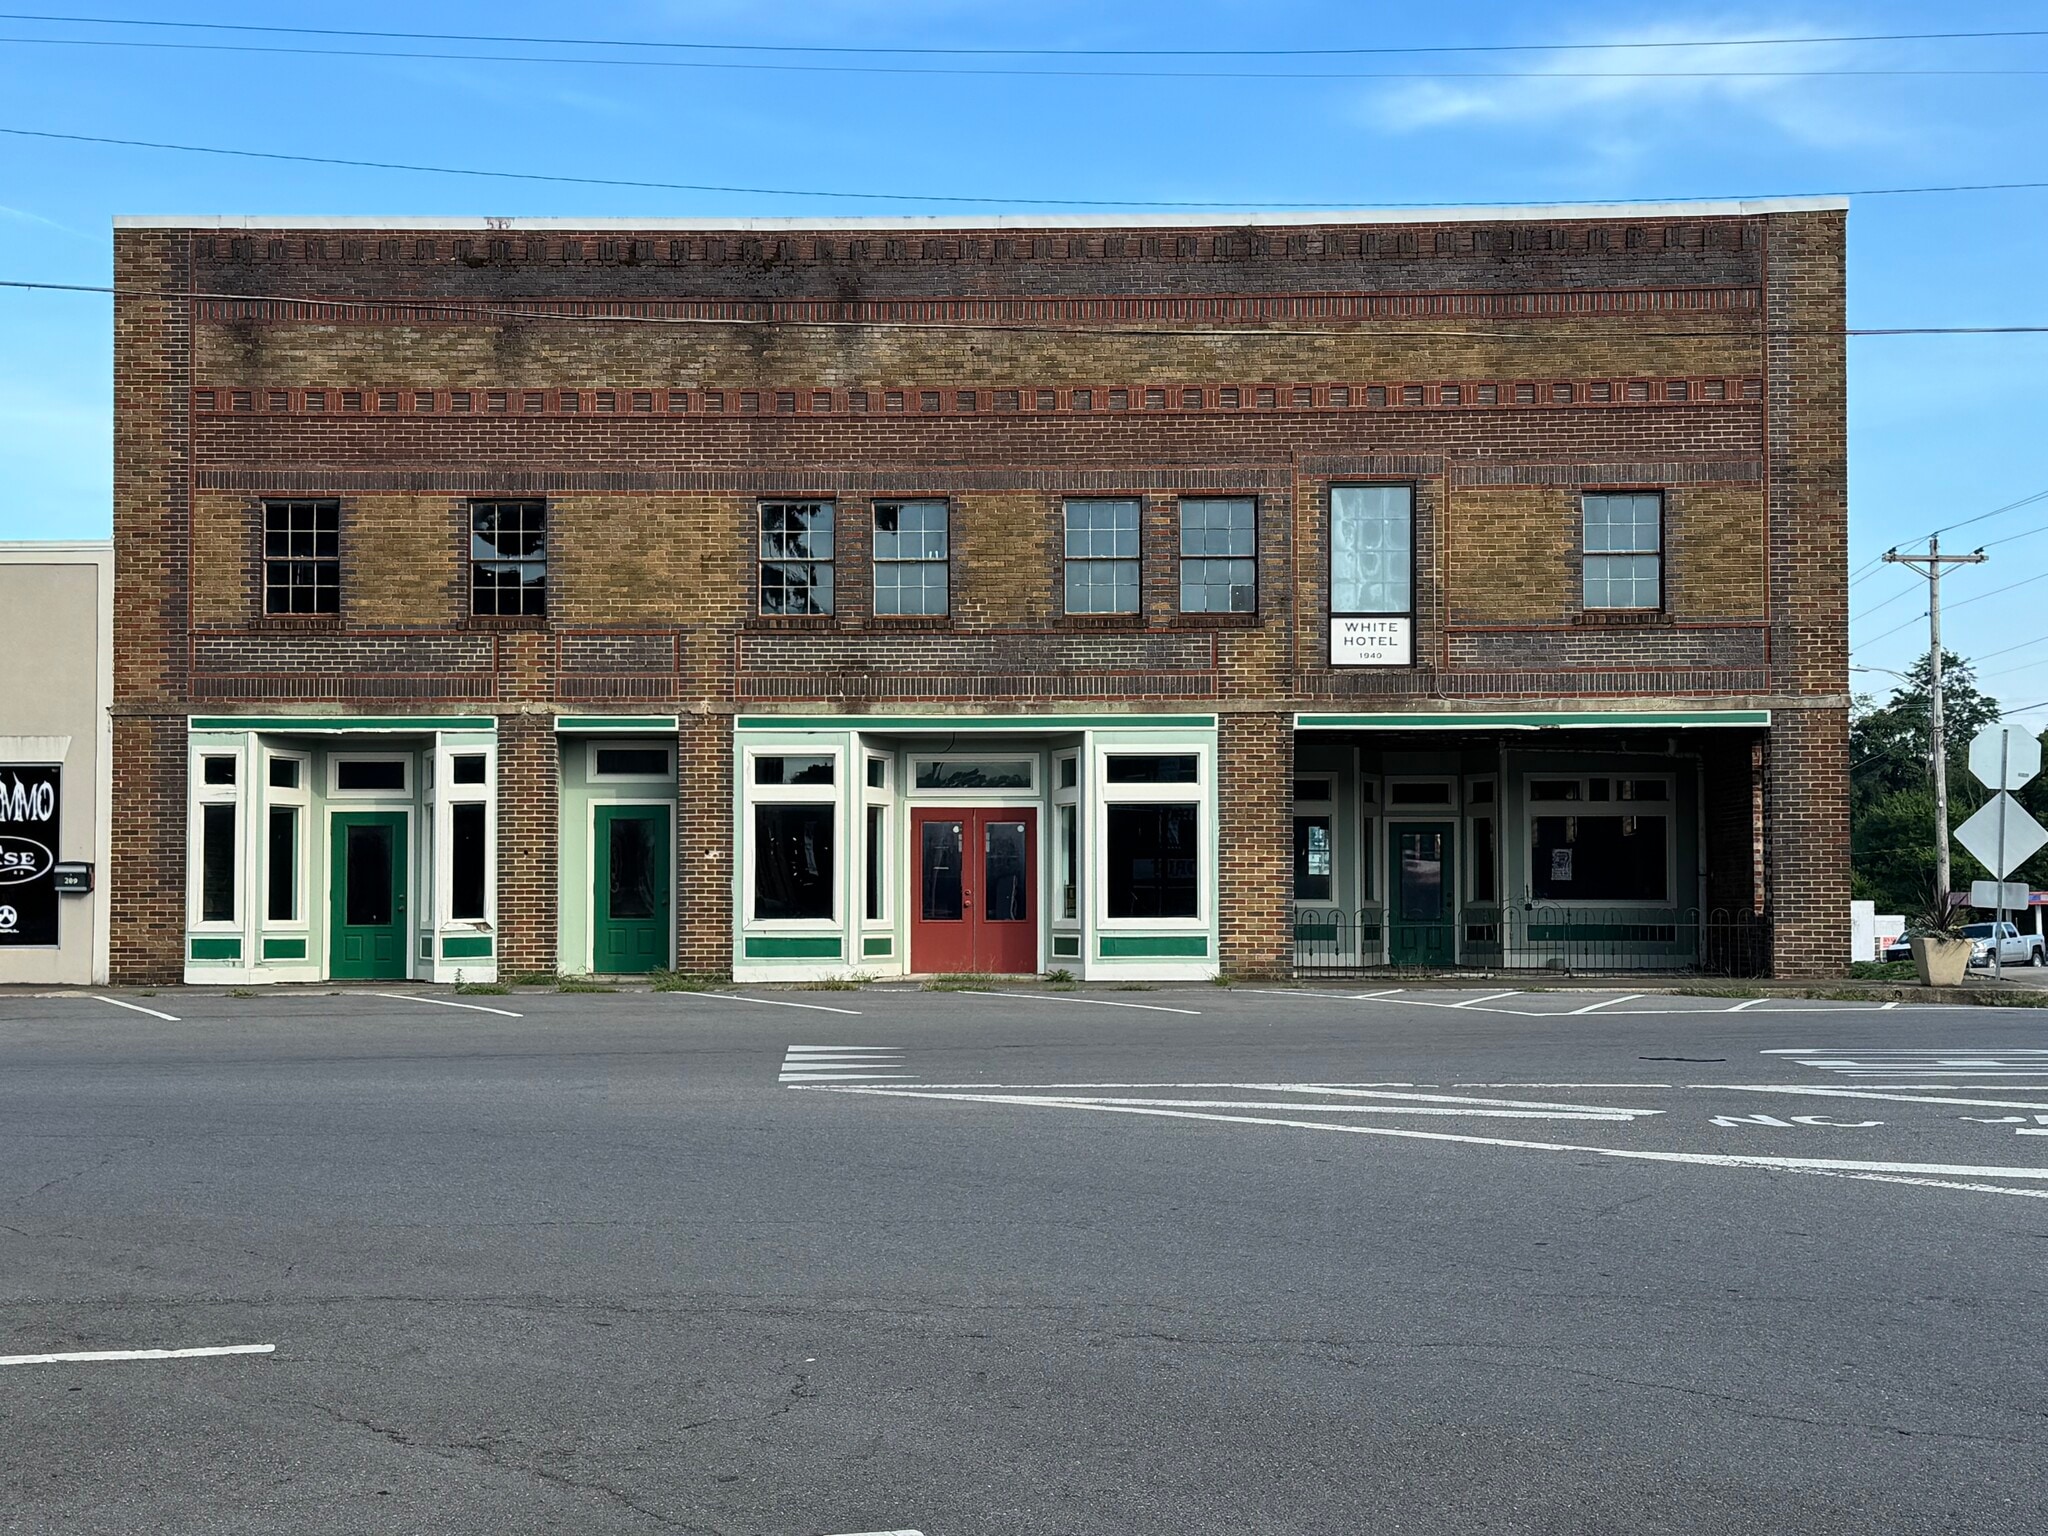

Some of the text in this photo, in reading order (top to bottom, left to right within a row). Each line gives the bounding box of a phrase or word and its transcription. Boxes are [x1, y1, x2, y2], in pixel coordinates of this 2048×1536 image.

[1344, 622, 1398, 632] WHITE
[1343, 636, 1398, 646] HOTEL
[0, 771, 54, 822] MMO
